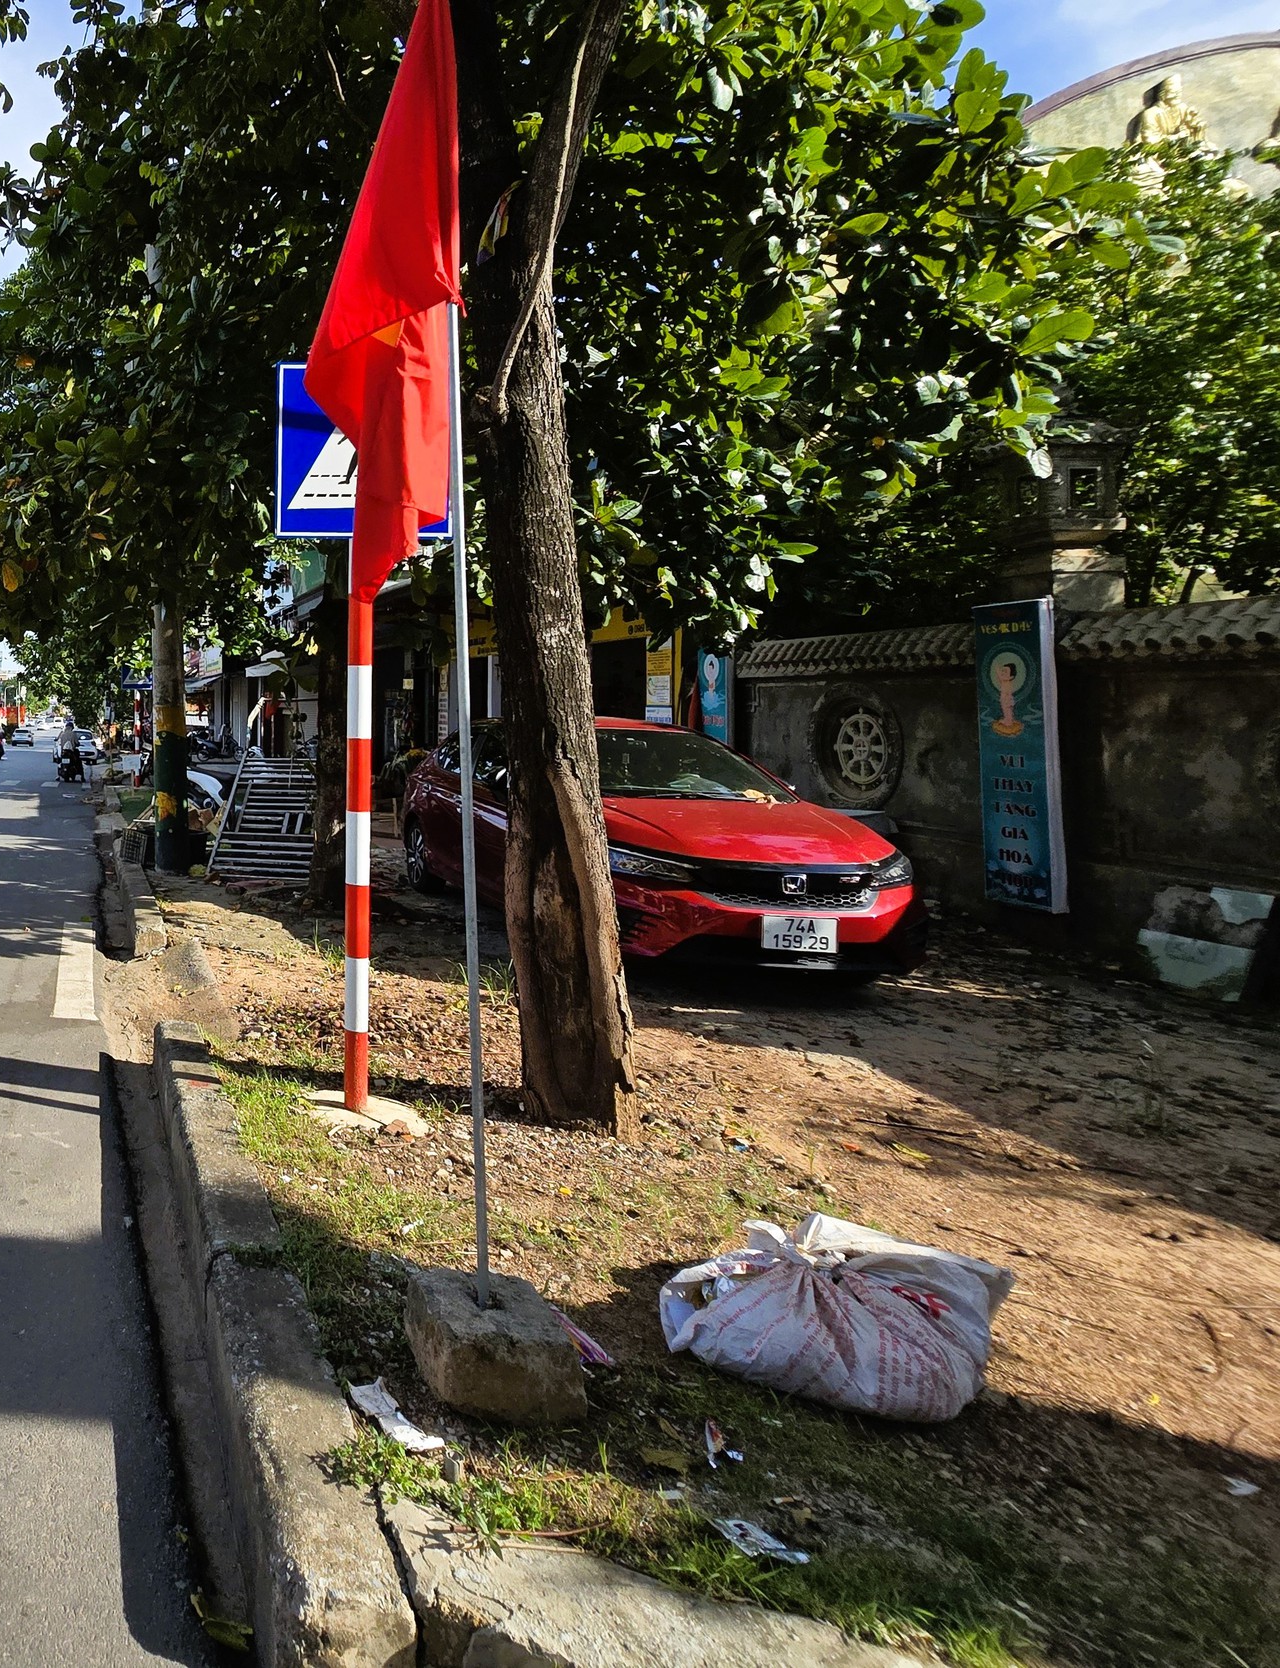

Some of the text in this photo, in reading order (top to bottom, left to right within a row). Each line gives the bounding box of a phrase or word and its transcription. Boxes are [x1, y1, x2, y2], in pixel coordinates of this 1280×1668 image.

[1000, 754, 1025, 768] VUI
[992, 777, 1035, 794] THAY
[785, 918, 816, 934] 74A
[773, 934, 830, 951] 159.29
